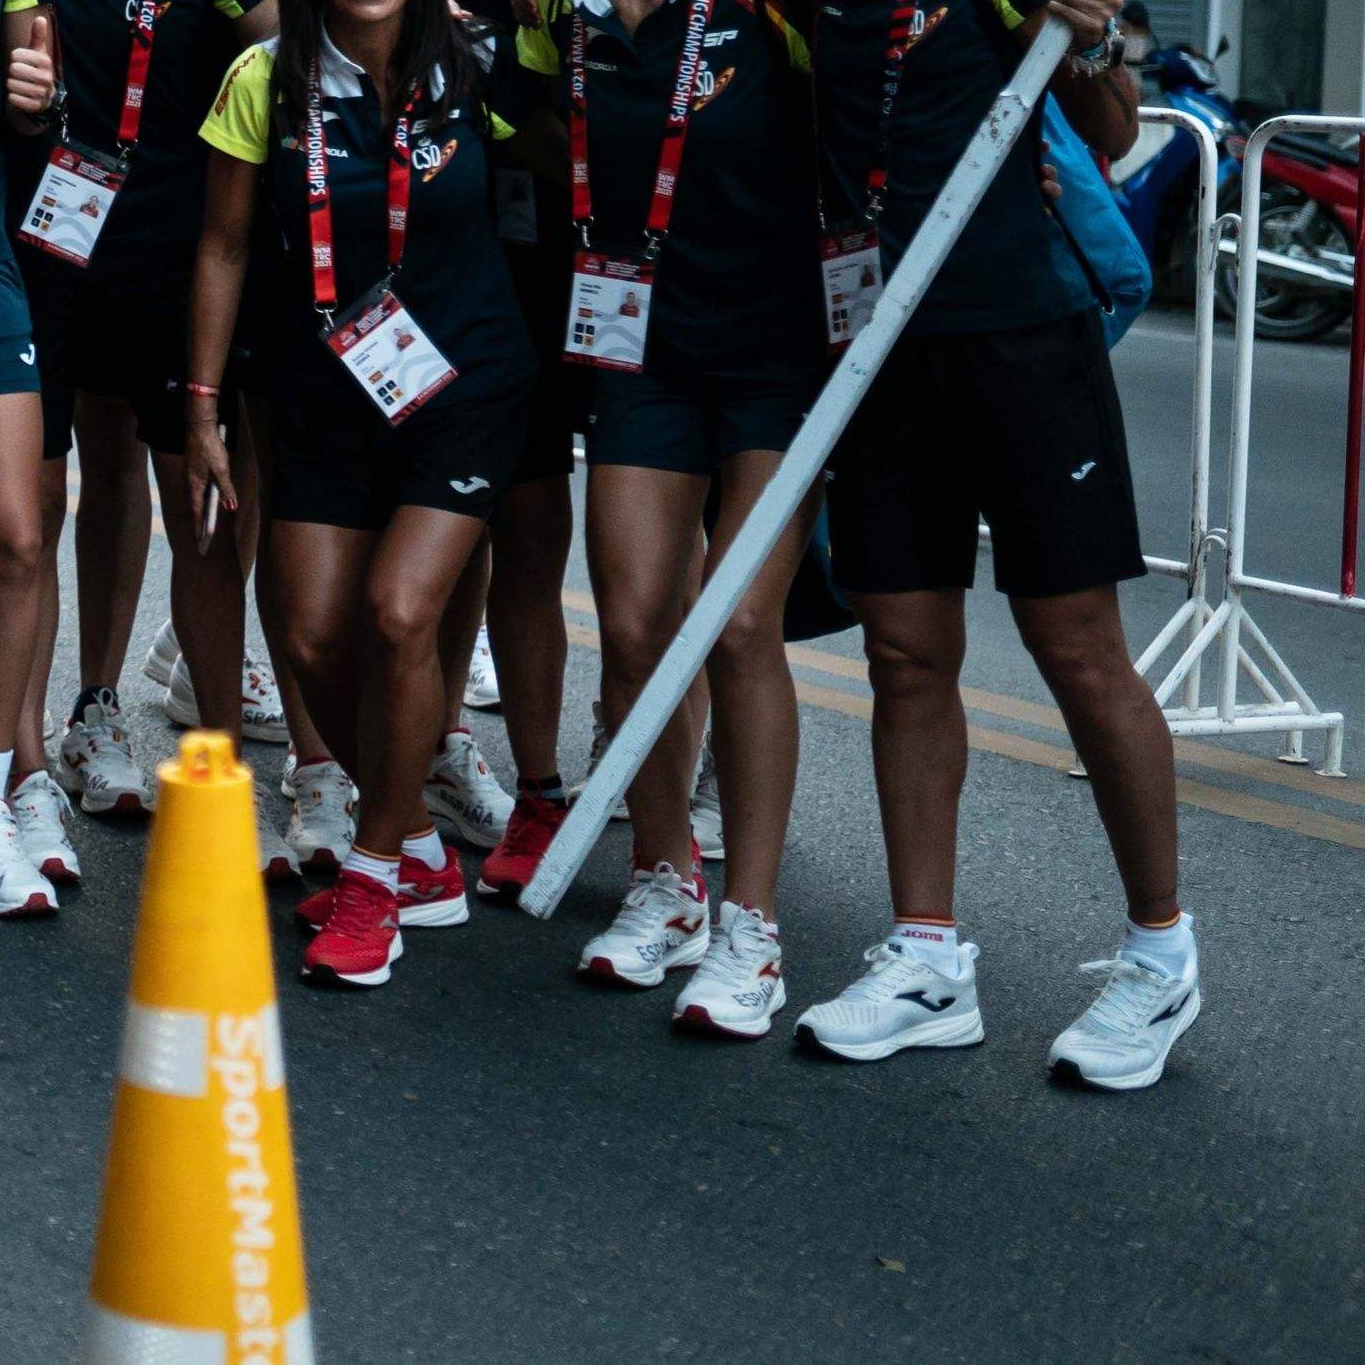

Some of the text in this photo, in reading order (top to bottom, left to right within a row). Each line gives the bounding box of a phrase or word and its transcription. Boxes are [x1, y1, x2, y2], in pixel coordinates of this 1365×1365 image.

[139, 1, 156, 31] 2021
[703, 30, 739, 47] SP
[669, 11, 706, 123] CHAMPIONSHIPS
[573, 68, 584, 99] 2021
[694, 71, 715, 96] SD
[411, 144, 441, 170] CSD
